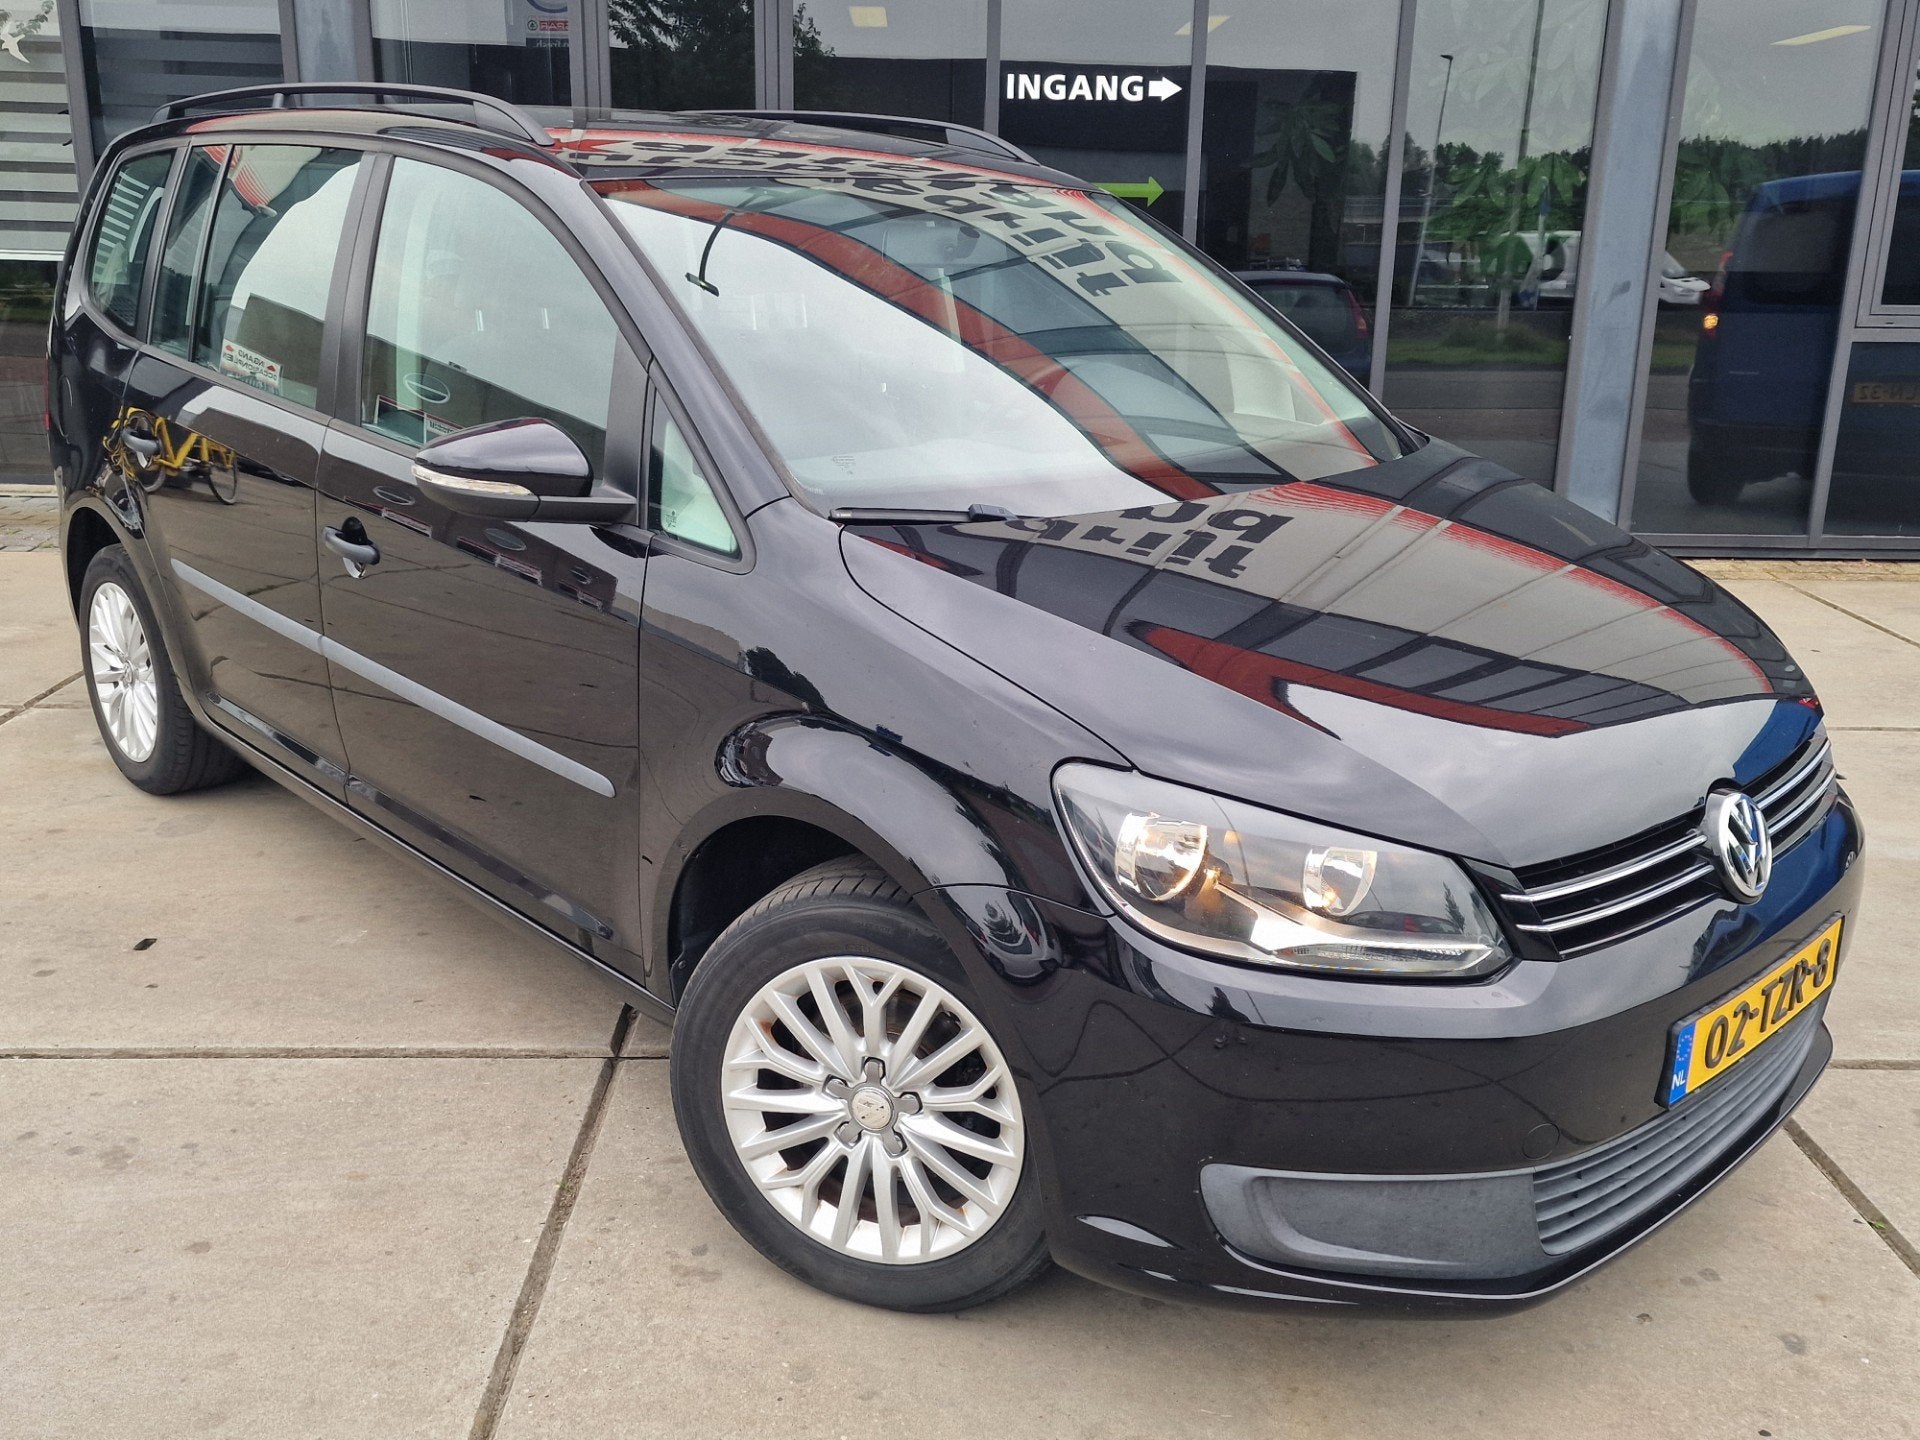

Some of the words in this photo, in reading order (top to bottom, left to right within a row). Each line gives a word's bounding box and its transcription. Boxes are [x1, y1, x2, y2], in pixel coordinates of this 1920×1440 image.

[1006, 73, 1144, 102] INGANG
[1704, 938, 1832, 1069] 02-TZR-8
[1672, 1070, 1686, 1090] NL
